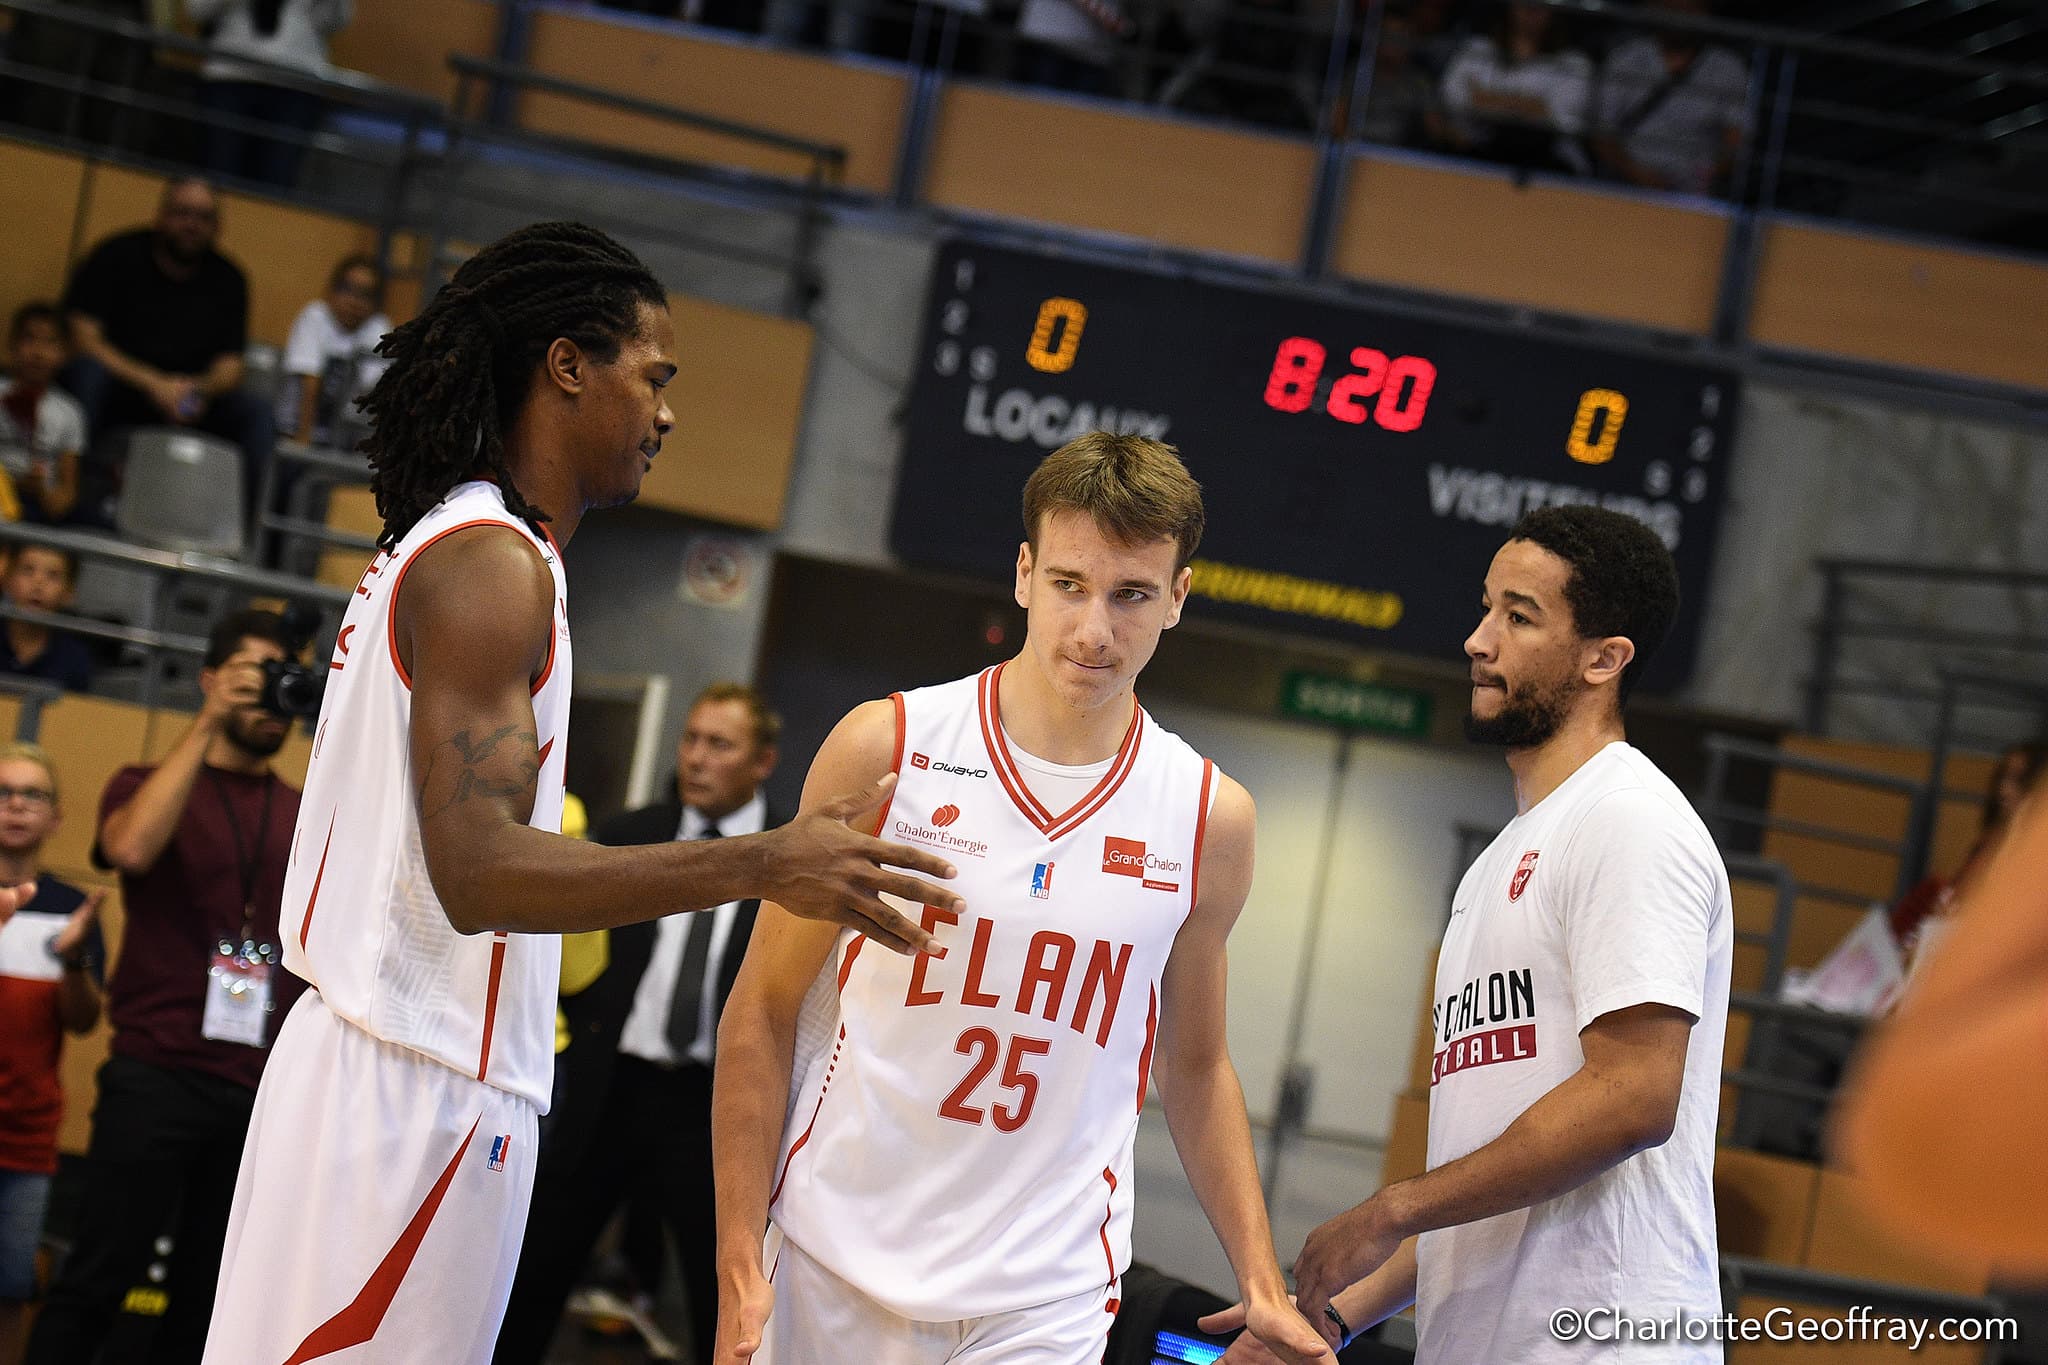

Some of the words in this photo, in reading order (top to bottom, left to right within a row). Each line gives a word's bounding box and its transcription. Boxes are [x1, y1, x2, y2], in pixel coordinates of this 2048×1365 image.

[1026, 297, 1088, 373] 0
[1566, 388, 1629, 464] 0
[904, 904, 1134, 1049] ELAN
[1443, 968, 1535, 1042] CALON
[937, 1026, 1052, 1134] 25
